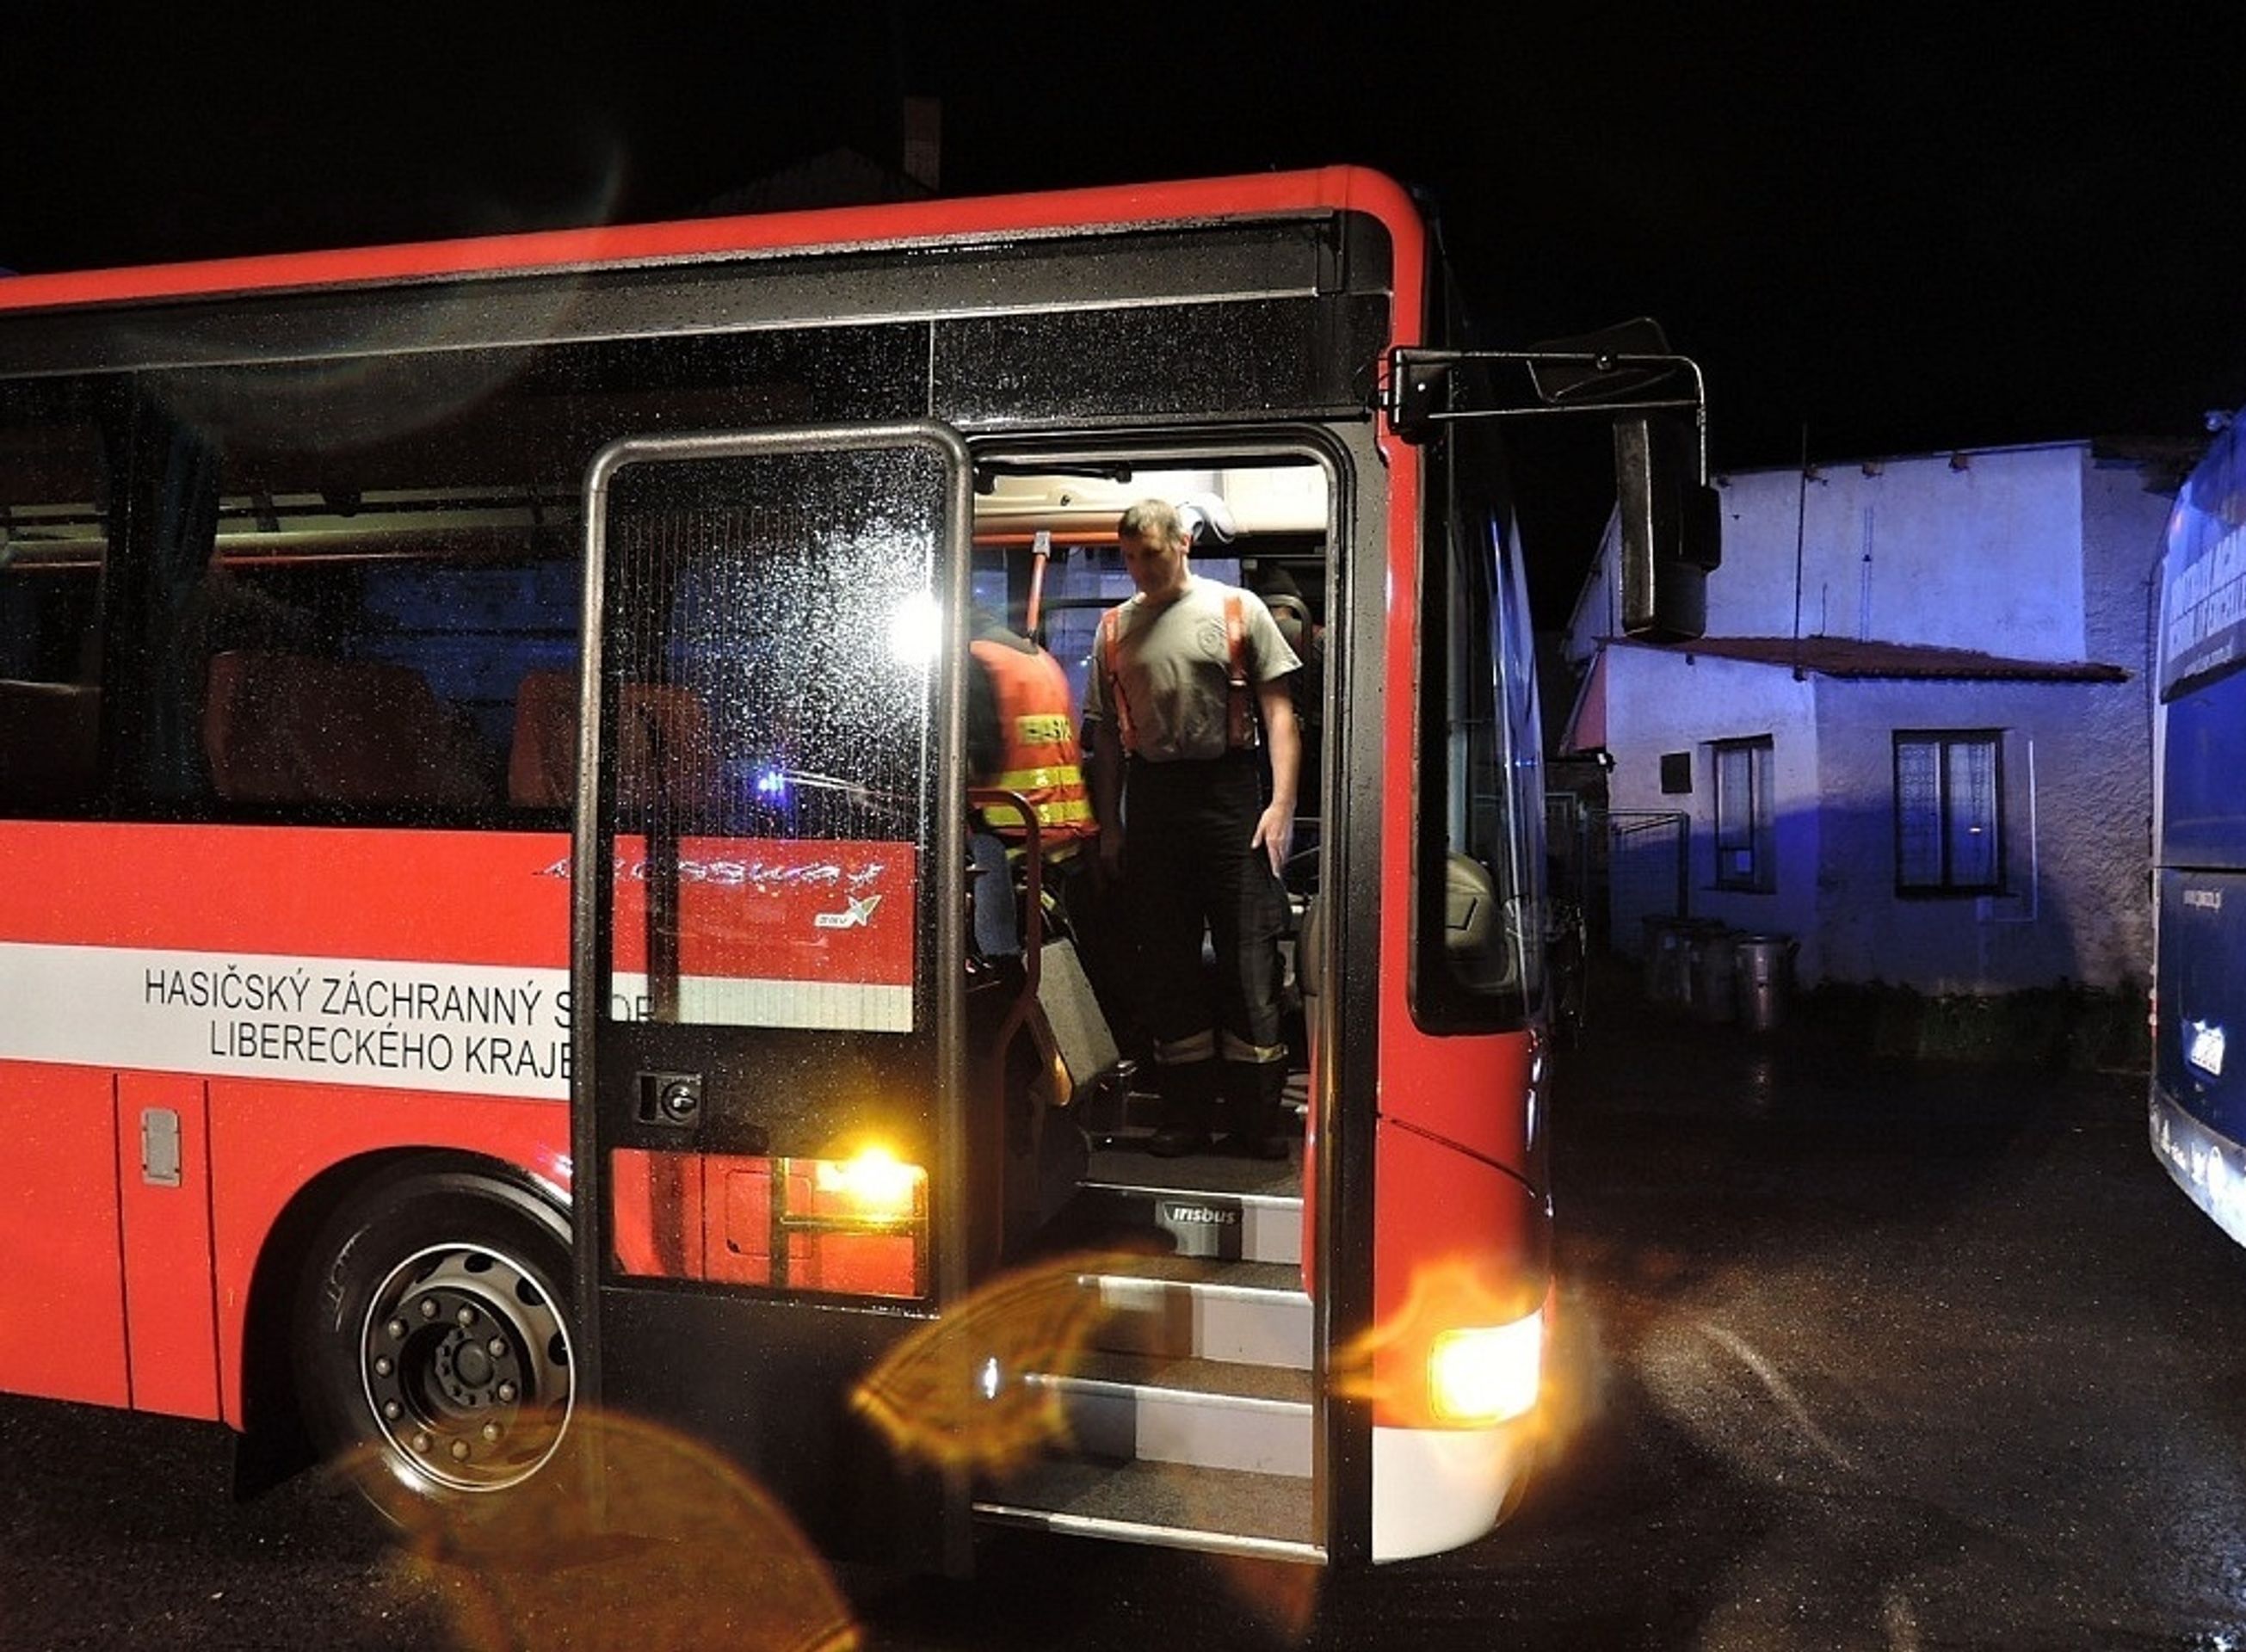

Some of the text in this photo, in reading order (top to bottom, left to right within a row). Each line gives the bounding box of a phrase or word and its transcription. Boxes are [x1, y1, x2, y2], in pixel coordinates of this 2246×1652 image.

[145, 964, 660, 1031] HASIČSKÝ ZÁCHRANNÝ SOR
[211, 1020, 453, 1072] LIBERECKÉHO
